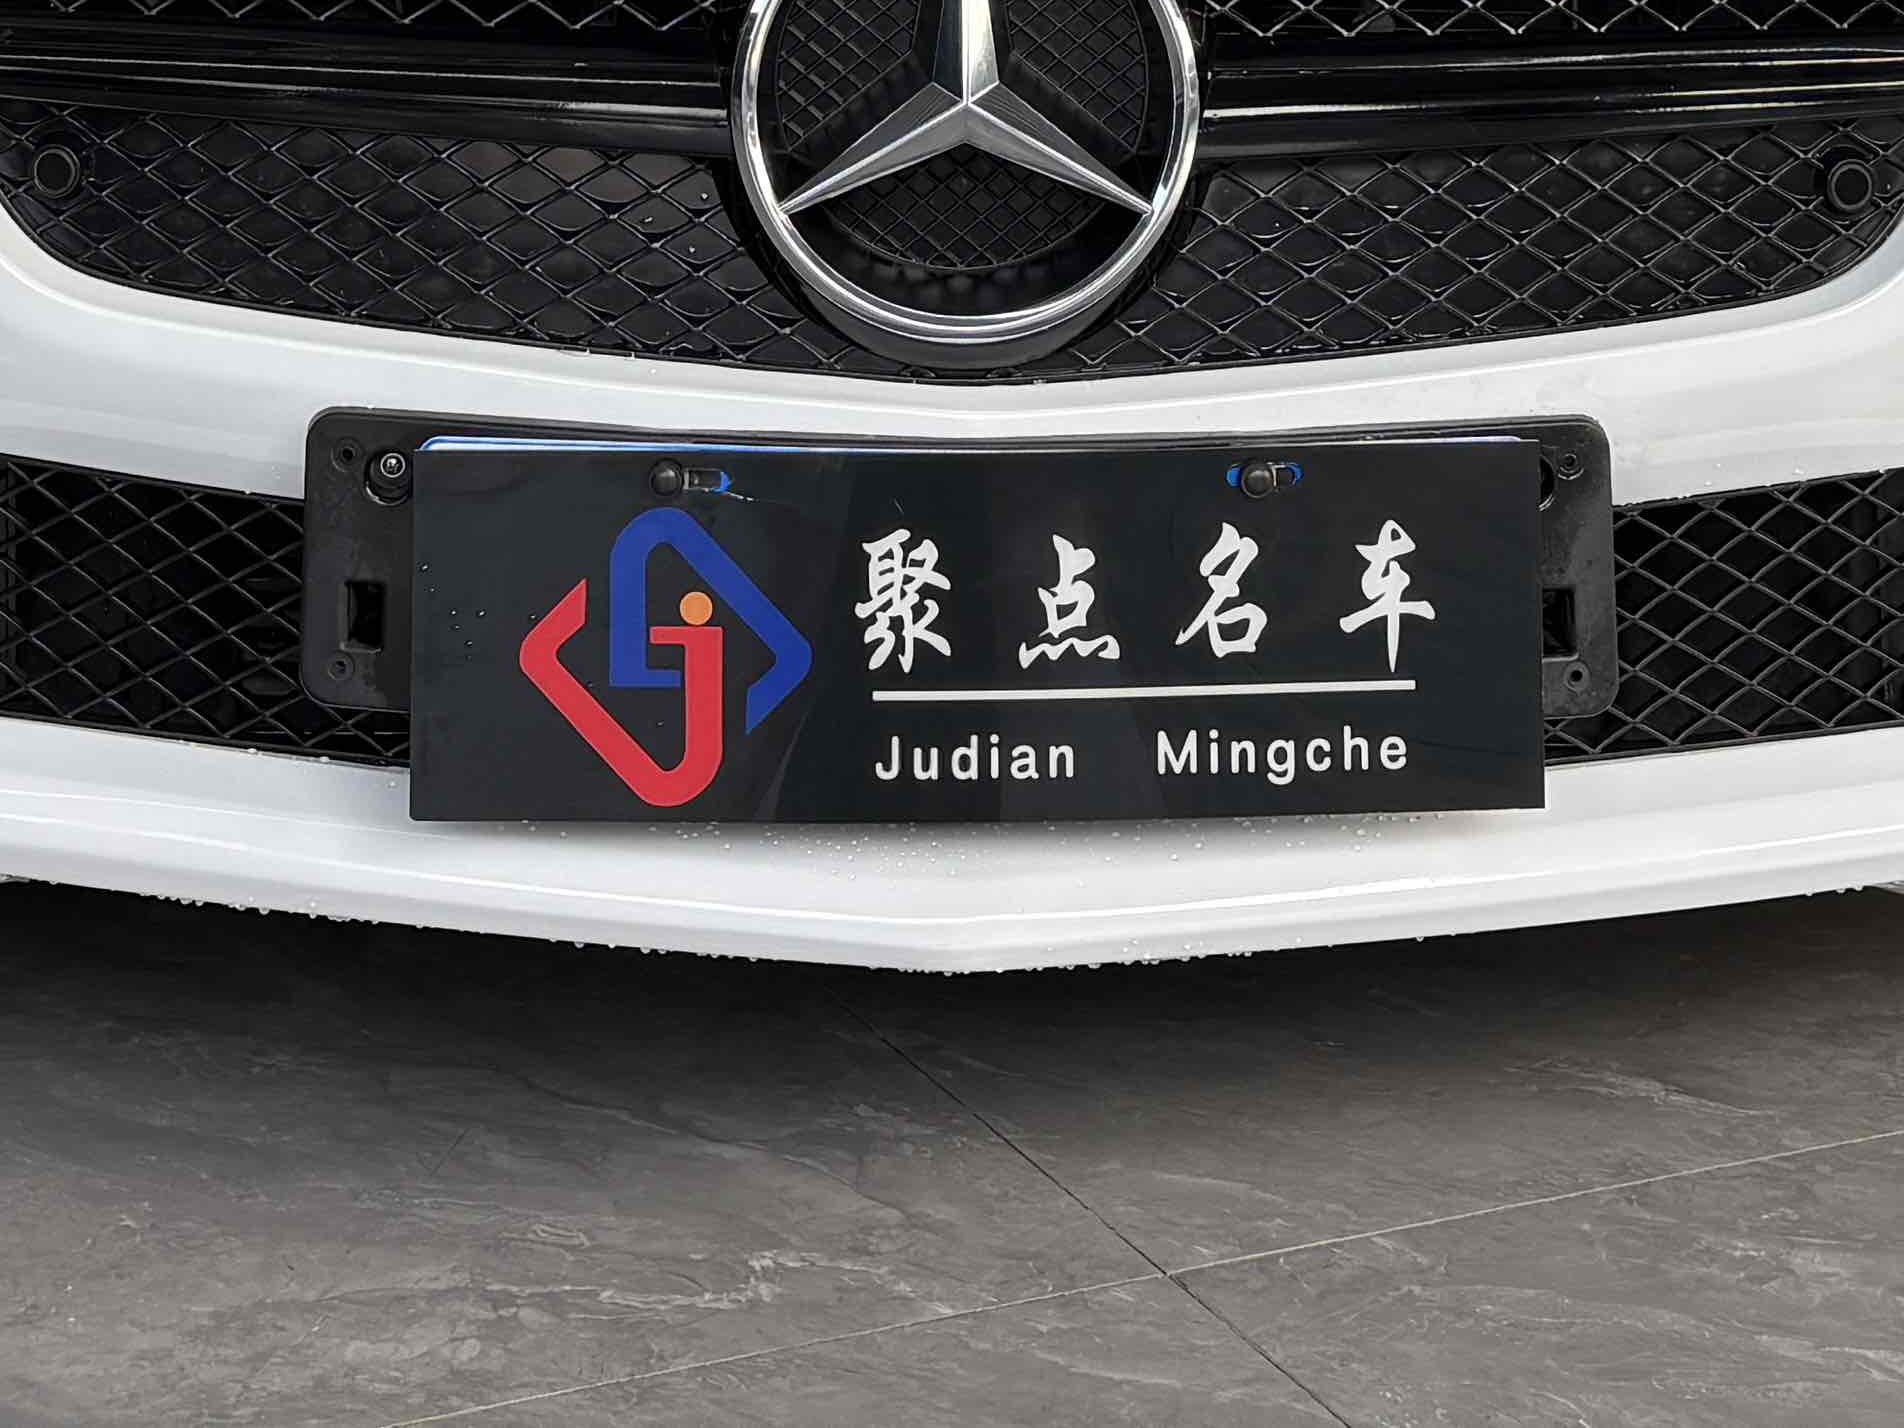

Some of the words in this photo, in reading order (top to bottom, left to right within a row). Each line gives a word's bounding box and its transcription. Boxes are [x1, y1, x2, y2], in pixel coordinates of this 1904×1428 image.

[854, 519, 1436, 673] 聚点名车
[874, 734, 1075, 781] Judian
[1156, 725, 1408, 785] Mingche
